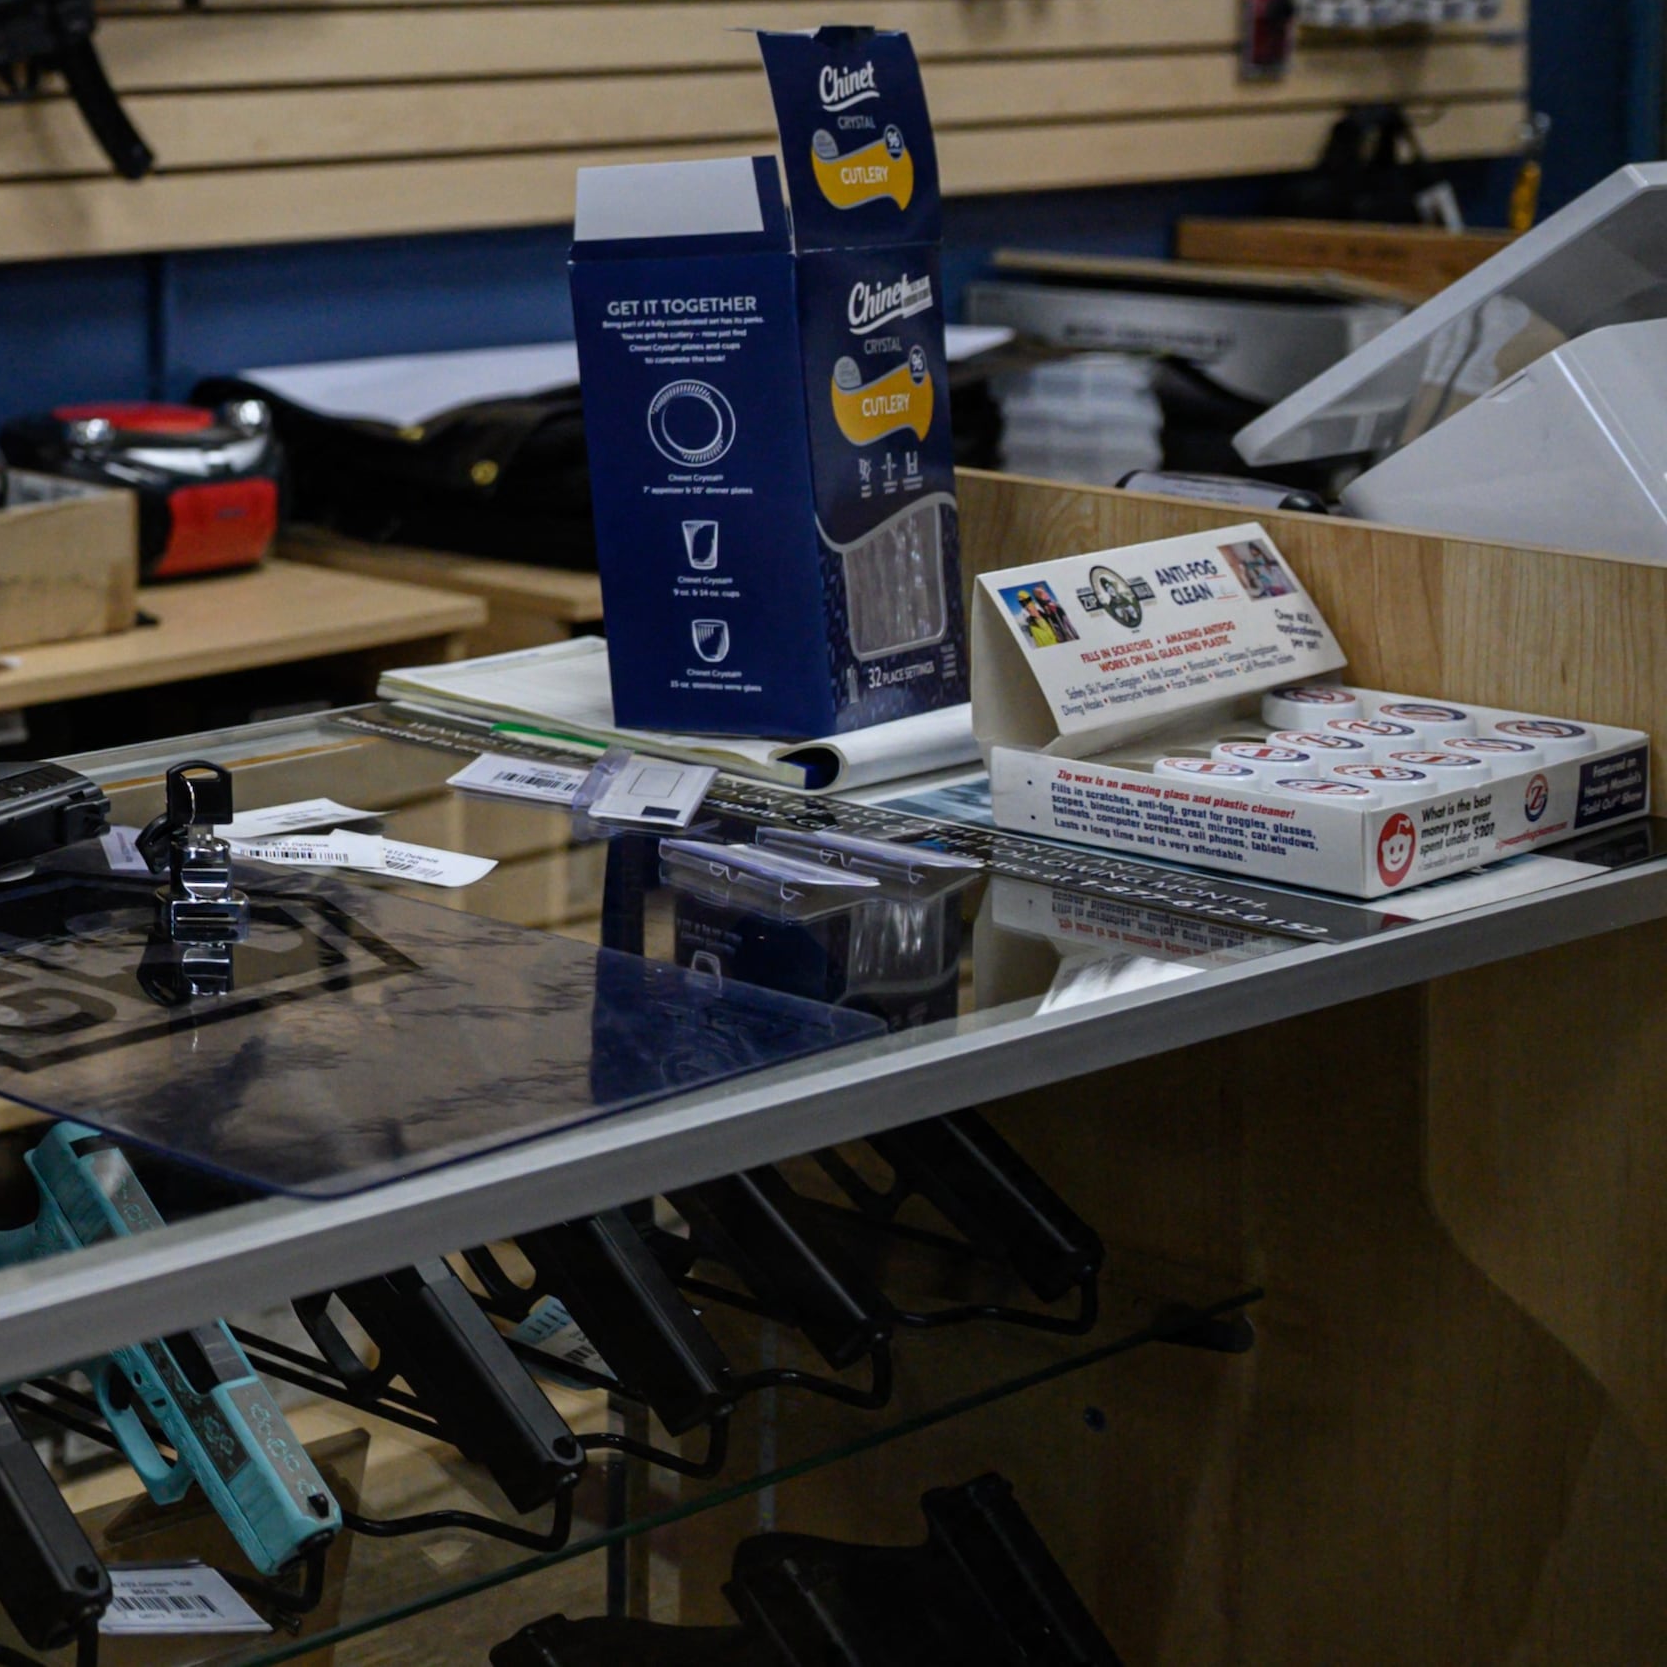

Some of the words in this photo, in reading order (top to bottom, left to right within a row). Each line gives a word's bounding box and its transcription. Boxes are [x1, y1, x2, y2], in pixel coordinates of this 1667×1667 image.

[819, 61, 875, 104] Chinet
[838, 116, 876, 130] CRYSTAL
[887, 130, 901, 149] 96
[840, 166, 889, 185] CUTLERY
[607, 301, 640, 316] GET
[643, 300, 658, 315] IT
[661, 296, 757, 314] TOGETHER
[666, 317, 708, 326] coordinated
[720, 316, 733, 324] has
[669, 331, 694, 340] cutlery
[681, 342, 704, 352] plates
[705, 342, 720, 350] and
[721, 343, 741, 351] cups
[864, 337, 903, 355] CRYSTAL
[655, 356, 691, 365] complete
[691, 355, 705, 363] the
[911, 354, 924, 372] 96
[862, 393, 911, 417] CUTLERY
[1155, 559, 1217, 586] ANTI-FOG
[1082, 594, 1098, 610] ZIP
[1170, 582, 1215, 606] CLEAN
[1275, 609, 1294, 620] Over
[1081, 650, 1101, 663] FILLS
[1102, 647, 1112, 659] IN
[1112, 638, 1154, 657] SCRATCHES
[1165, 628, 1203, 645] AMAZING
[1203, 620, 1236, 635] ANTIFOG
[1276, 623, 1324, 638] applications
[1099, 658, 1130, 673] WORKS
[1131, 653, 1144, 665] ON
[1145, 650, 1159, 662] ALL
[1160, 645, 1184, 659] GLASS
[1184, 641, 1201, 653] AND
[1201, 635, 1232, 650] PLASTIC
[1291, 638, 1304, 650] per
[868, 666, 883, 689] 32
[883, 667, 904, 685] PLACE
[904, 660, 935, 680] SETTINGS
[1593, 757, 1626, 778] Featured
[1627, 758, 1636, 768] on
[1057, 769, 1072, 781] Zip
[1074, 774, 1093, 784] wax
[1095, 776, 1104, 786] is
[1107, 779, 1118, 788] an
[1121, 782, 1161, 798] amazing
[1163, 788, 1189, 801] glass
[1192, 794, 1211, 805] and
[1213, 798, 1249, 812] plastic
[1251, 804, 1296, 820] cleaner!
[1584, 781, 1608, 798] Howie
[1621, 791, 1643, 805] Show
[1051, 782, 1071, 795] Fills
[1074, 786, 1083, 796] in
[1085, 790, 1135, 807] scratches,
[1137, 799, 1178, 815] anti-fog,
[1181, 806, 1207, 818] great
[1209, 810, 1223, 822] for
[1226, 814, 1270, 831] goggles,
[1273, 822, 1316, 839] glasses,
[1421, 806, 1446, 822] What
[1447, 802, 1455, 815] is
[1457, 797, 1470, 812] the
[1473, 794, 1492, 809] best
[1052, 795, 1088, 809] scopes,
[1090, 800, 1144, 819] binoculars,
[1147, 811, 1205, 831] sunglasses,
[1207, 823, 1248, 838] mirrors,
[1251, 830, 1267, 841] car
[1270, 832, 1319, 852] windows,
[1053, 804, 1094, 821] helmets,
[1096, 813, 1141, 828] computer
[1143, 822, 1186, 838] screens,
[1187, 830, 1206, 841] cell
[1209, 834, 1249, 850] phones,
[1251, 840, 1287, 856] tablets
[1421, 822, 1451, 839] money
[1453, 818, 1470, 833] you
[1472, 811, 1491, 825] ever
[1054, 817, 1079, 830] Lasts
[1090, 823, 1111, 838] long
[1113, 829, 1135, 841] time
[1137, 835, 1155, 847] and
[1158, 838, 1167, 848] is
[1169, 840, 1190, 853] very
[1193, 844, 1248, 863] affordable.
[1420, 839, 1443, 857] spent
[1445, 830, 1472, 847] under
[1473, 822, 1495, 840] $20?
[977, 835, 1087, 860] MONTH
[1089, 858, 1155, 875] AND
[1162, 873, 1211, 887] THE
[977, 845, 1148, 884] FOLLOWING
[1149, 881, 1267, 910] MONTH.
[1042, 872, 1074, 882] at
[1079, 880, 1329, 934] 1-877-612-0152
